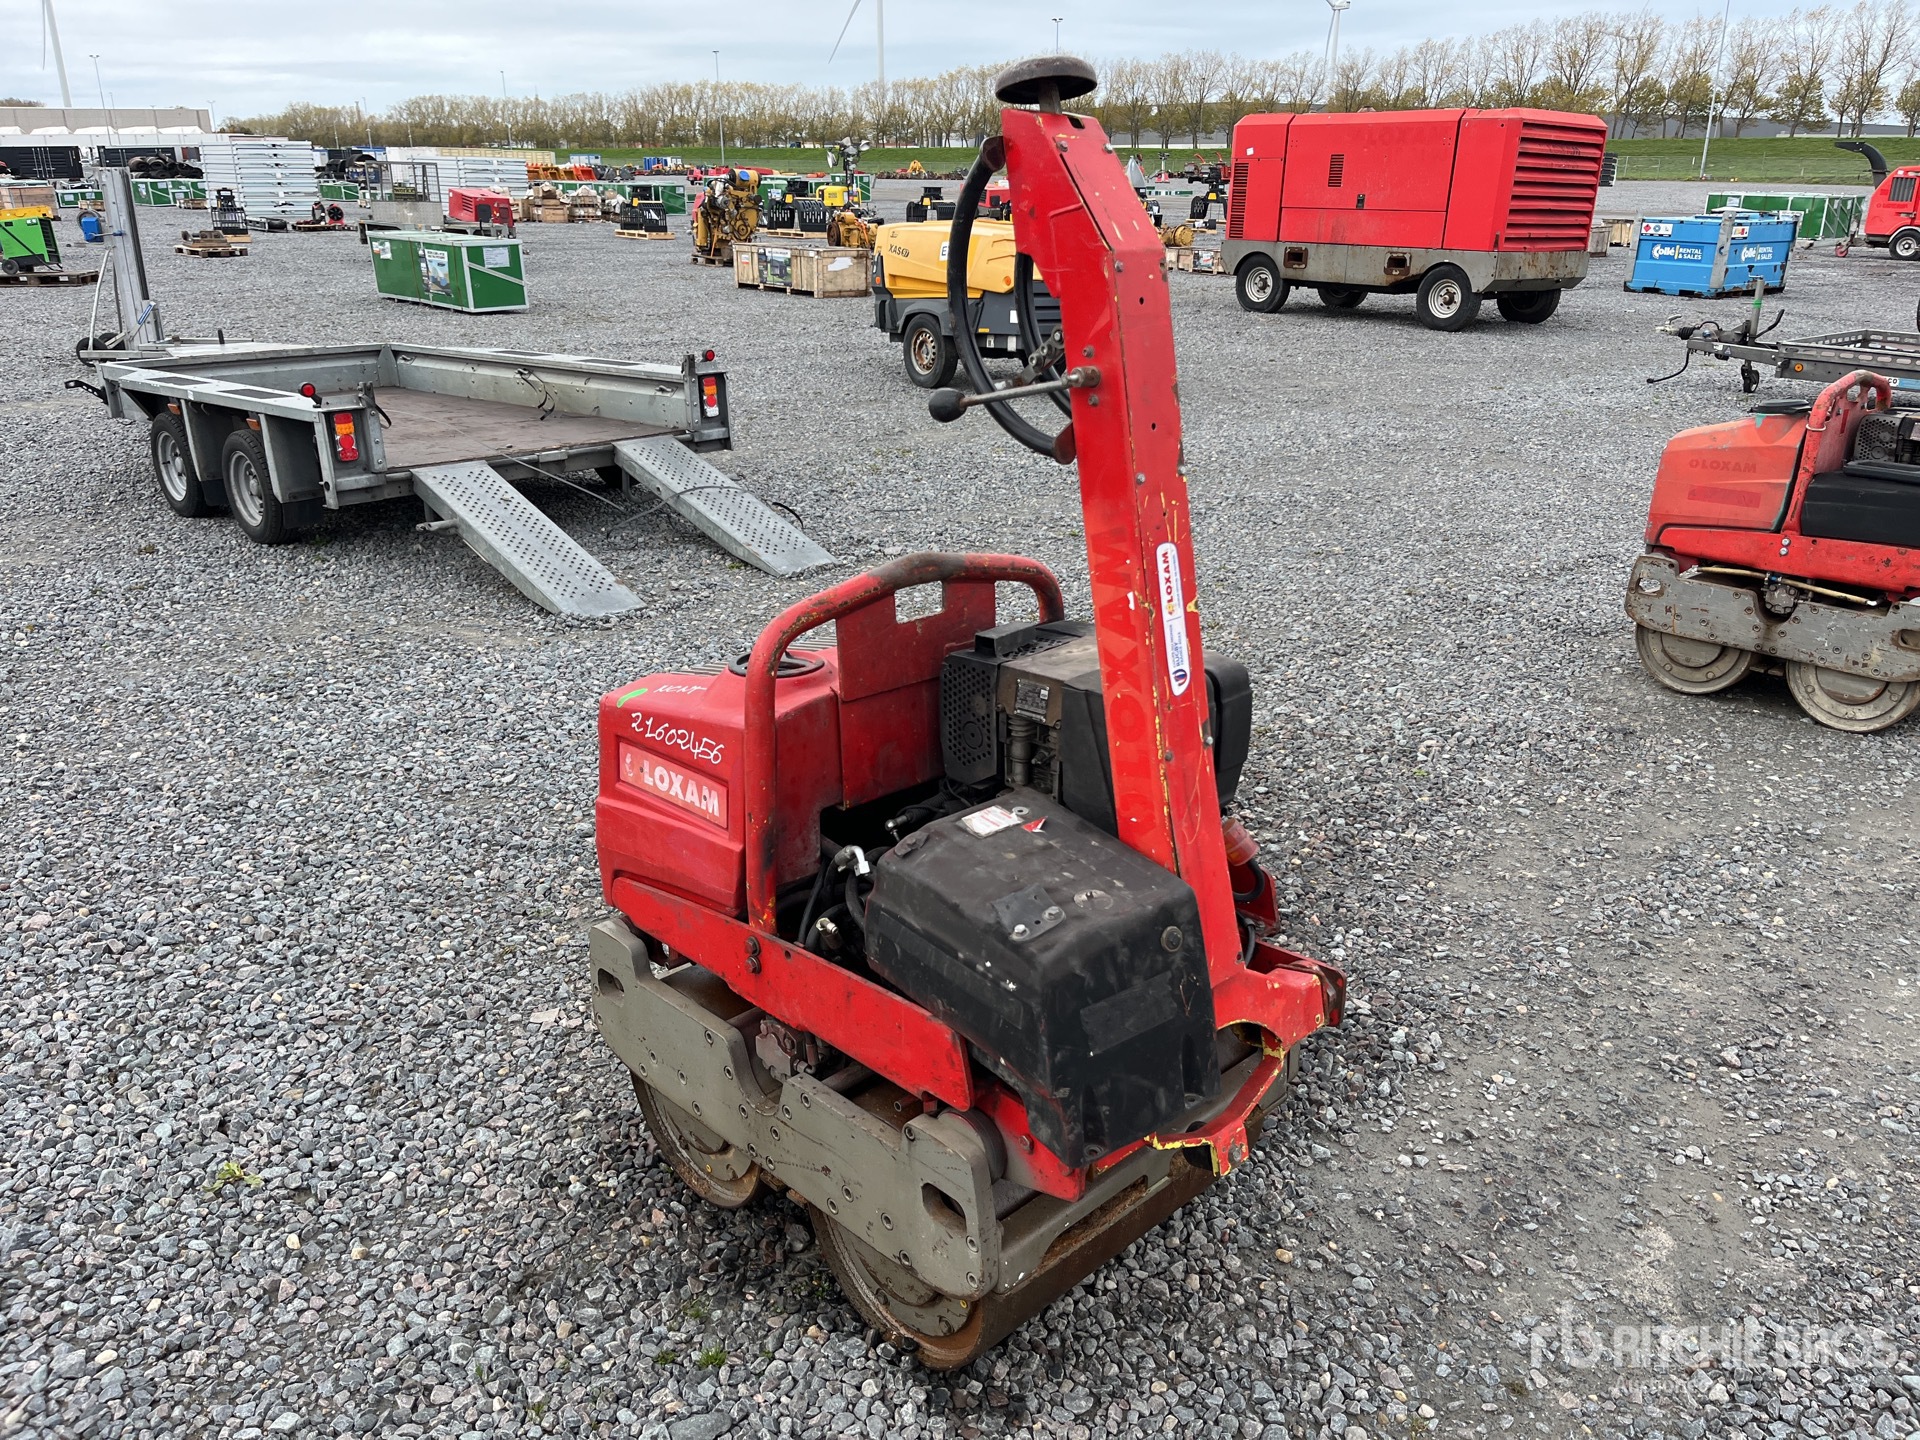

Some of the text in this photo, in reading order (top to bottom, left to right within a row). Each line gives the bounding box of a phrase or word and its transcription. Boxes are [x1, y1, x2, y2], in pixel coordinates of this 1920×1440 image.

[1652, 244, 1675, 260] Collé
[1161, 551, 1173, 603] LOXAM
[631, 712, 725, 765] 21602456
[643, 759, 720, 817] LOXAM
